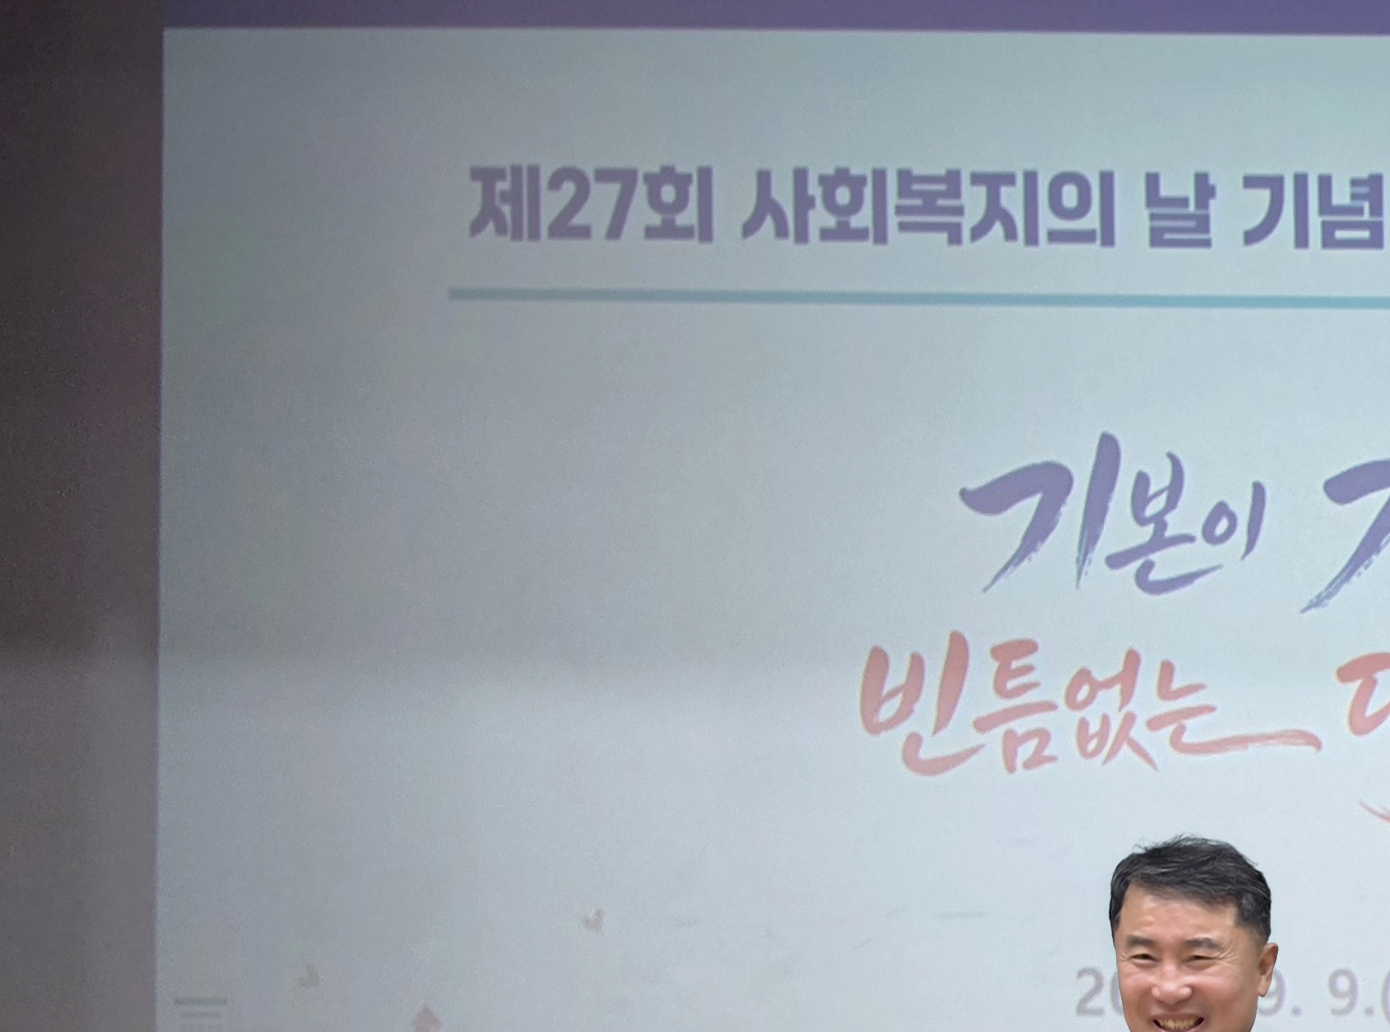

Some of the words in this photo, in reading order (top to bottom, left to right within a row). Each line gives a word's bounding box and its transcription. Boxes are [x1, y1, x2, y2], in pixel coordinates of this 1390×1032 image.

[468, 164, 714, 244] 제27회
[741, 166, 1116, 248] 사회복지의
[1143, 171, 1216, 250] 날
[1242, 171, 1386, 251] 기념
[959, 431, 1267, 597] 기본이
[859, 629, 1323, 776] 빈틈없는
